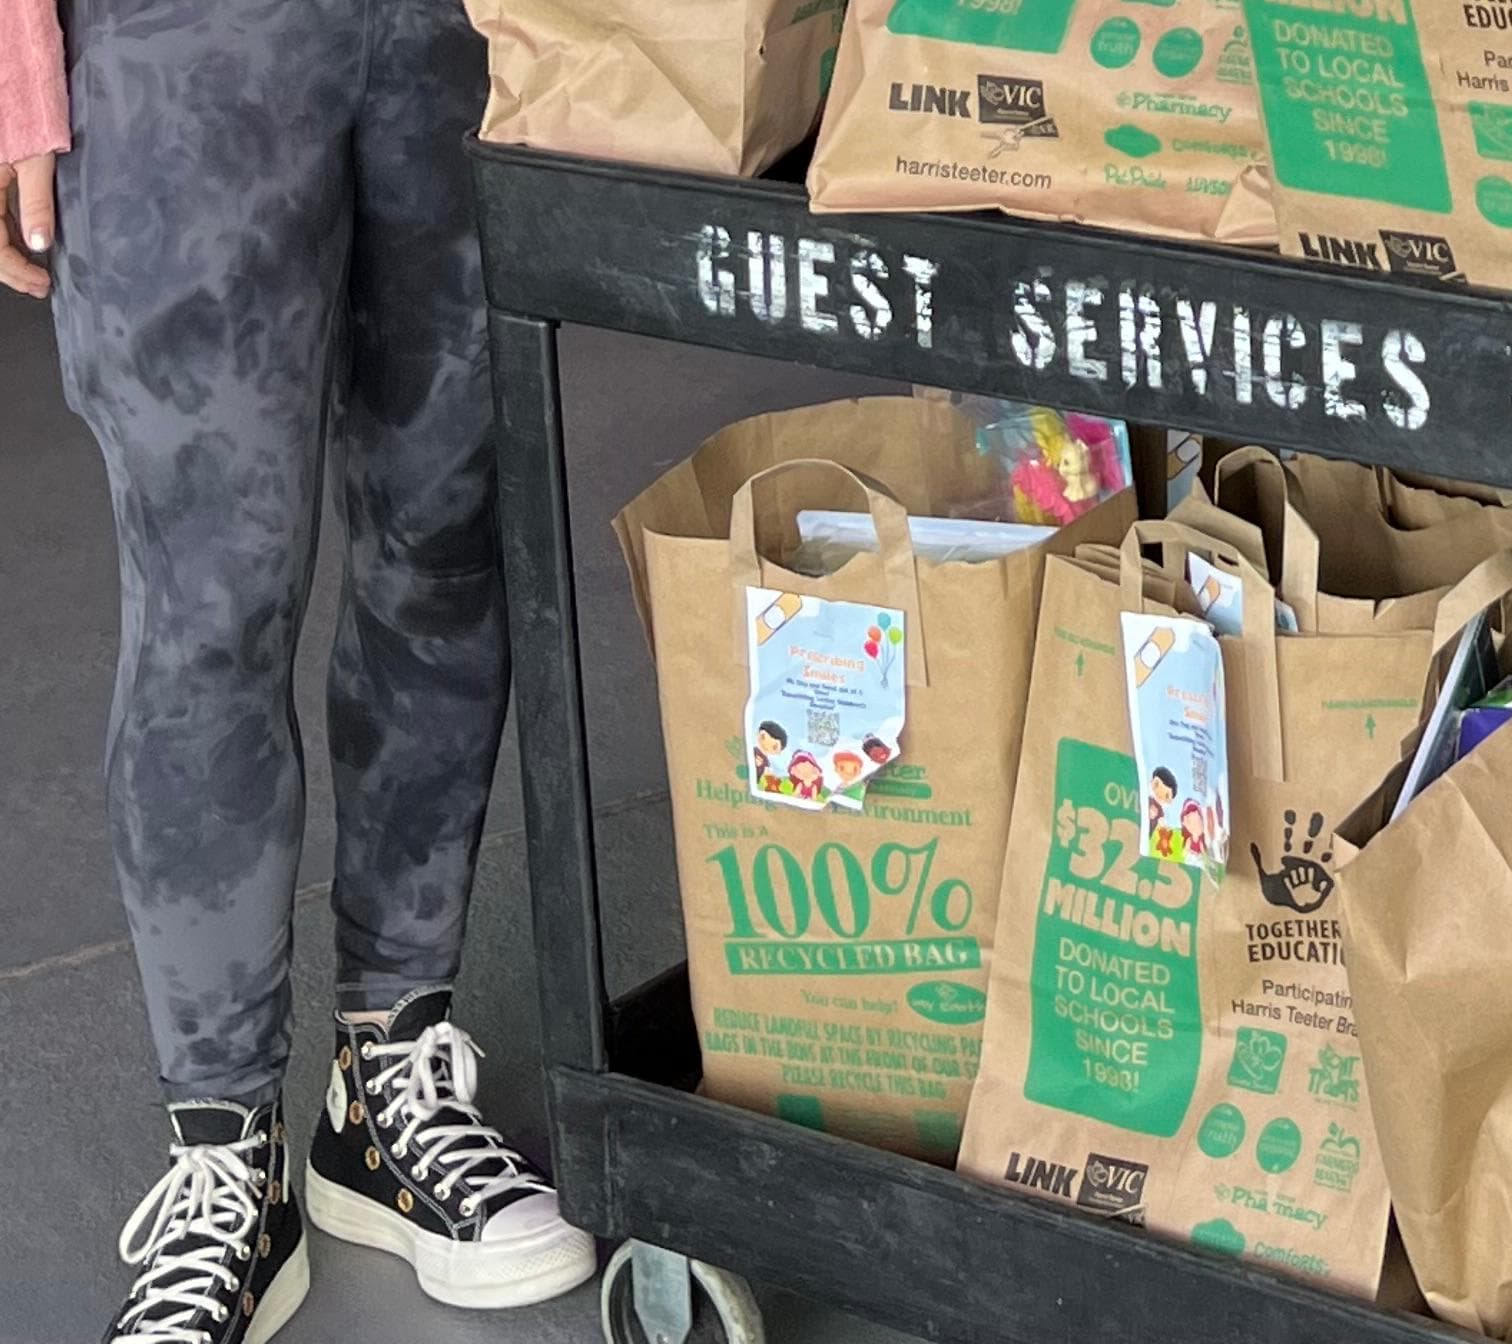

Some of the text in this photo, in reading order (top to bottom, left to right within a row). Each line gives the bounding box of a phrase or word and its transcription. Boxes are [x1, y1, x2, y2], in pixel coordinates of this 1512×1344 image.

[1274, 20, 1394, 57] DONATED
[1278, 47, 1405, 90] TO LOCAL
[1456, 70, 1510, 93] Harris
[888, 81, 1043, 119] LINK VIC
[1132, 91, 1232, 124] Pharmacy
[1285, 77, 1408, 117] SCHOOLS
[1312, 110, 1388, 144] SINCE
[895, 155, 1052, 190] harristeeter.com
[1299, 231, 1450, 270] LINK VIC
[695, 223, 940, 348] GUEST
[1009, 274, 1431, 430] SERVICES
[1056, 799, 1193, 912] $32.5
[705, 836, 974, 940] 100%
[1044, 879, 1191, 957] MILLION
[740, 937, 968, 971] RECYCLED BAG
[1058, 937, 1171, 985] DONATED
[1247, 941, 1347, 964] EDUCATI
[1054, 967, 1175, 1014] TO LOCAL
[1261, 978, 1353, 1010] Participatin
[1053, 993, 1175, 1040] SCHOOLS
[1231, 999, 1281, 1020] Harris
[1286, 1004, 1334, 1031] Teeter
[1074, 1031, 1149, 1066] SINCE
[1003, 1151, 1146, 1198] LINK VIC
